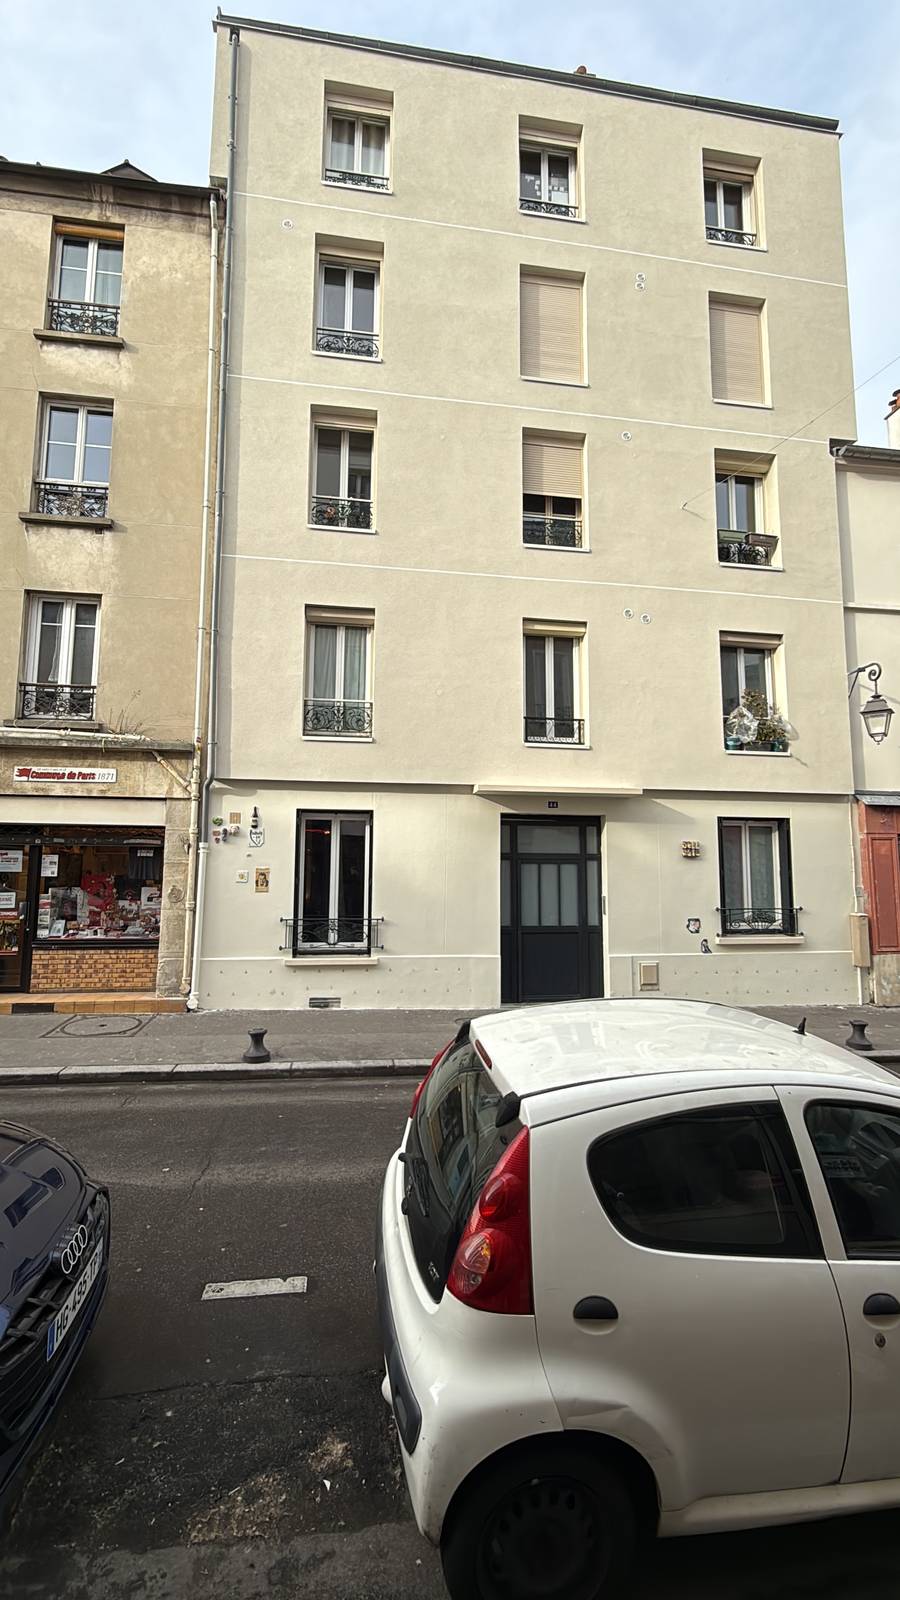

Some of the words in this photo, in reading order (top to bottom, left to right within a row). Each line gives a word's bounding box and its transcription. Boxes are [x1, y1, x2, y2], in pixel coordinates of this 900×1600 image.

[30, 771, 65, 780] Commune
[67, 771, 76, 780] de
[77, 772, 96, 780] Paris
[97, 772, 114, 780] 1871
